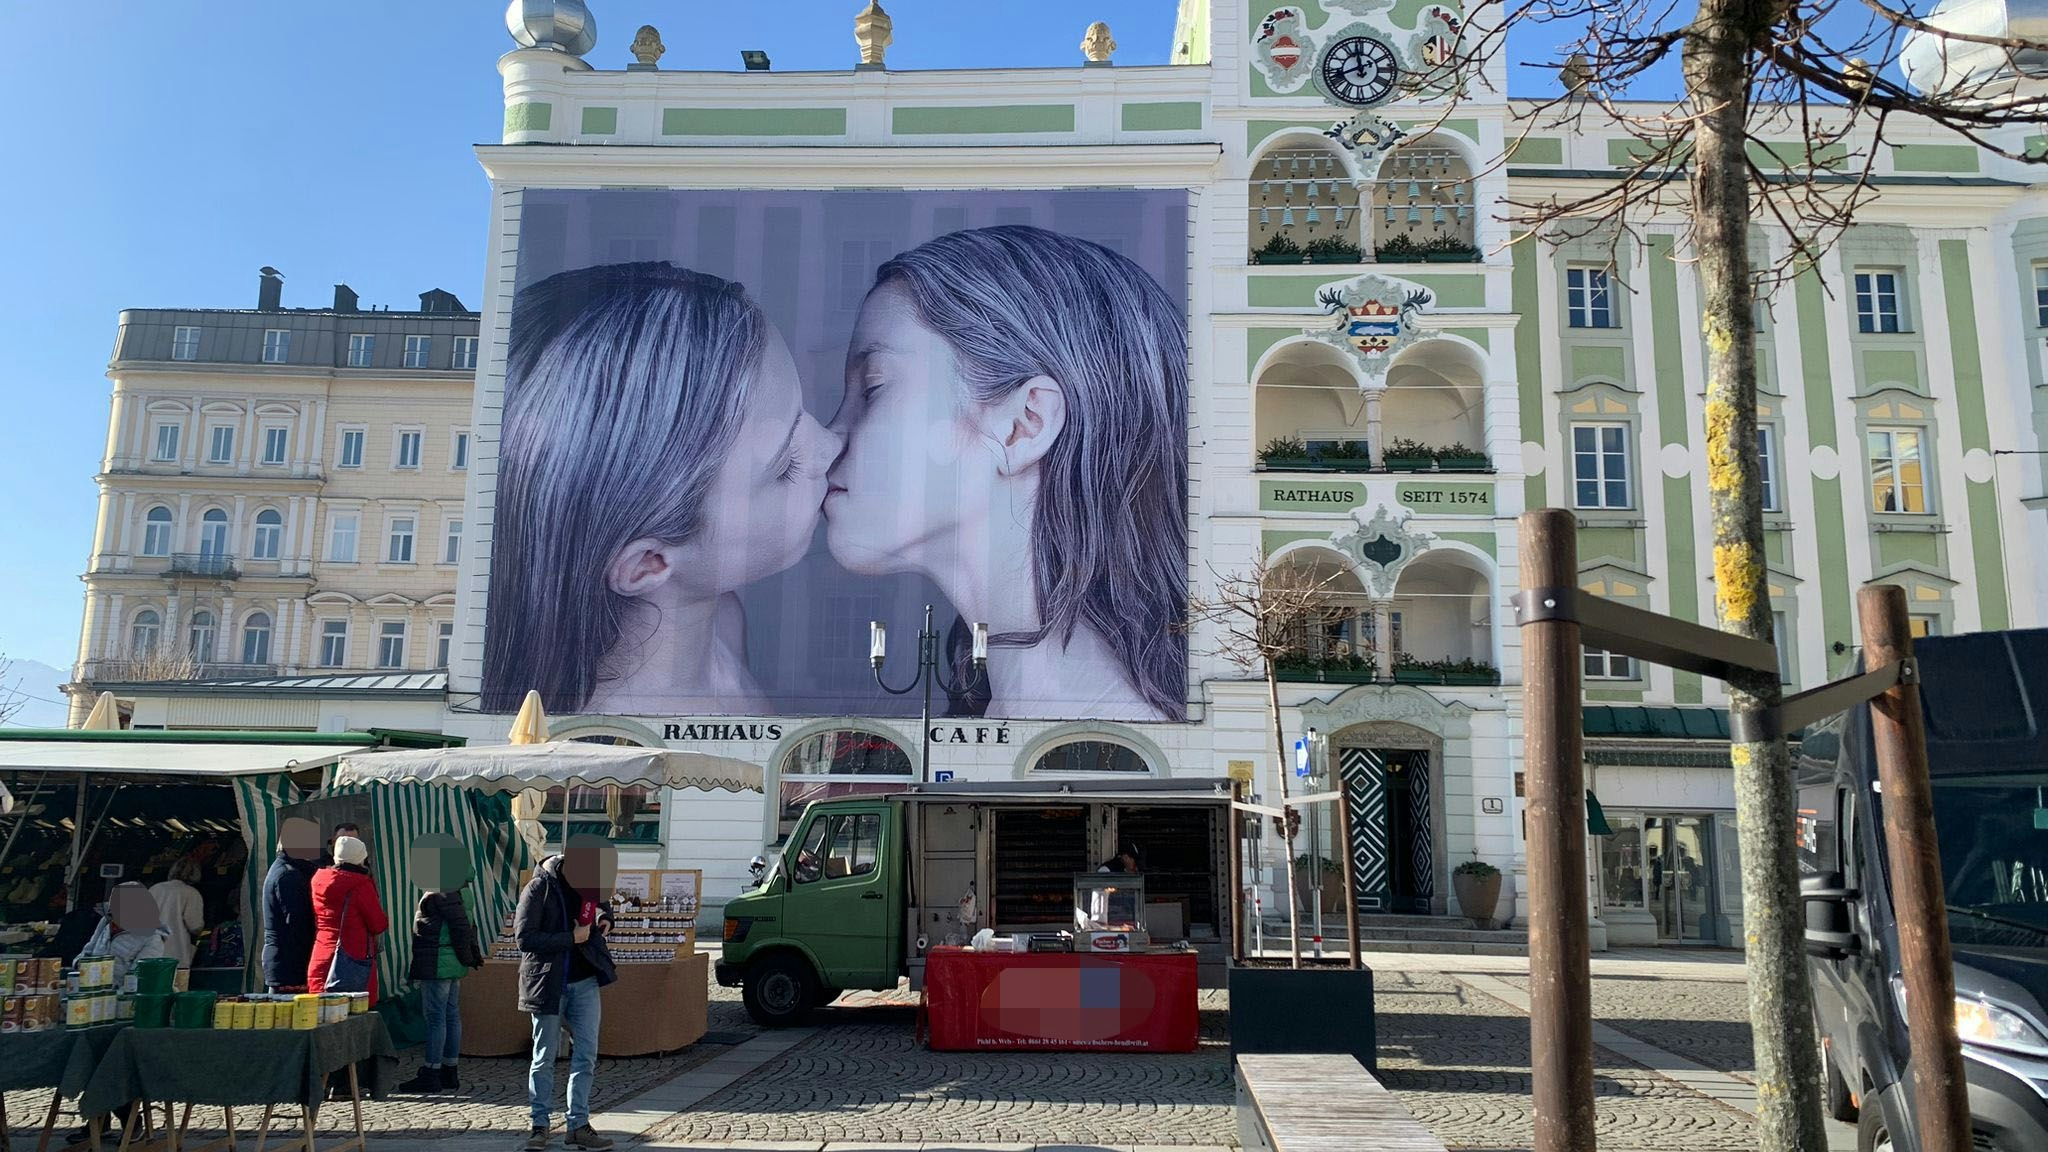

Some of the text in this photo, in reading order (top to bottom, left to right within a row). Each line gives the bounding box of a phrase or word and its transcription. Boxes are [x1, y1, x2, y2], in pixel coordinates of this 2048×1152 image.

[1273, 489, 1489, 504] RATHAUS SEIT 1574
[663, 723, 1011, 744] RATHAUS CAFÉ
